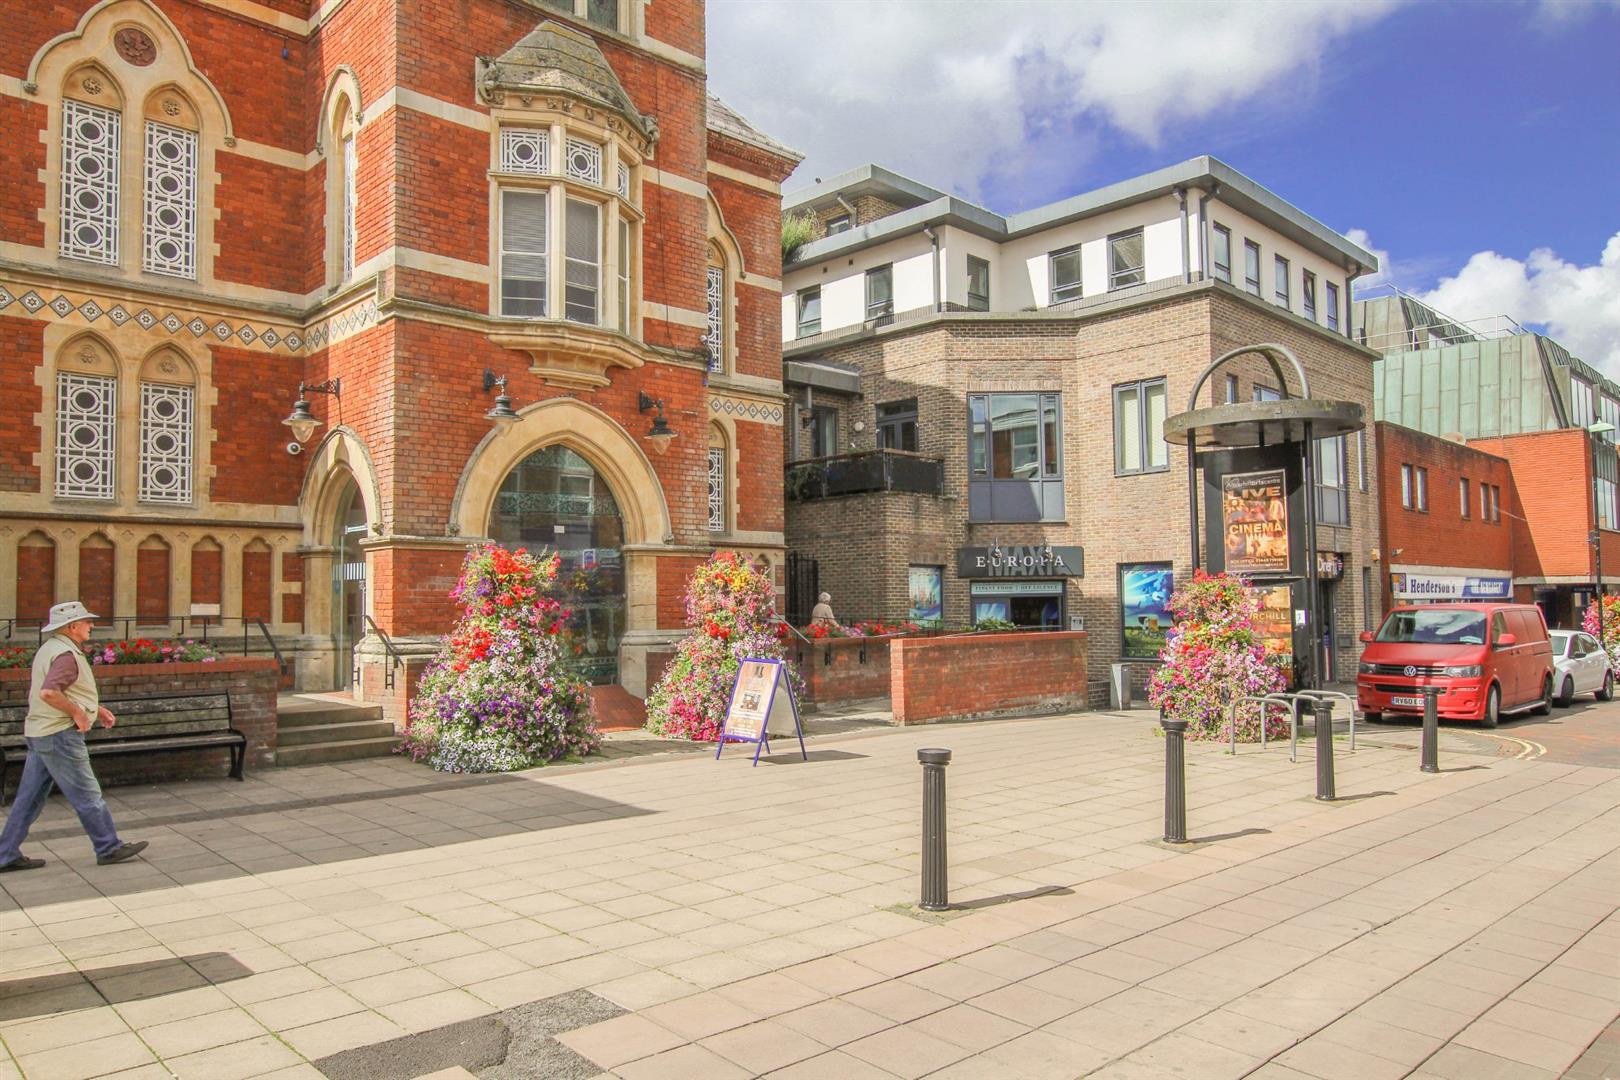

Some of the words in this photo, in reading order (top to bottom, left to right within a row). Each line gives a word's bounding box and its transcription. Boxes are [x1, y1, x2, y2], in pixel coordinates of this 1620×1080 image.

[1227, 486, 1281, 499] LIVE
[1229, 522, 1282, 535] CINEMA
[1410, 579, 1456, 593] Henderson's
[1248, 612, 1287, 620] URCHILL
